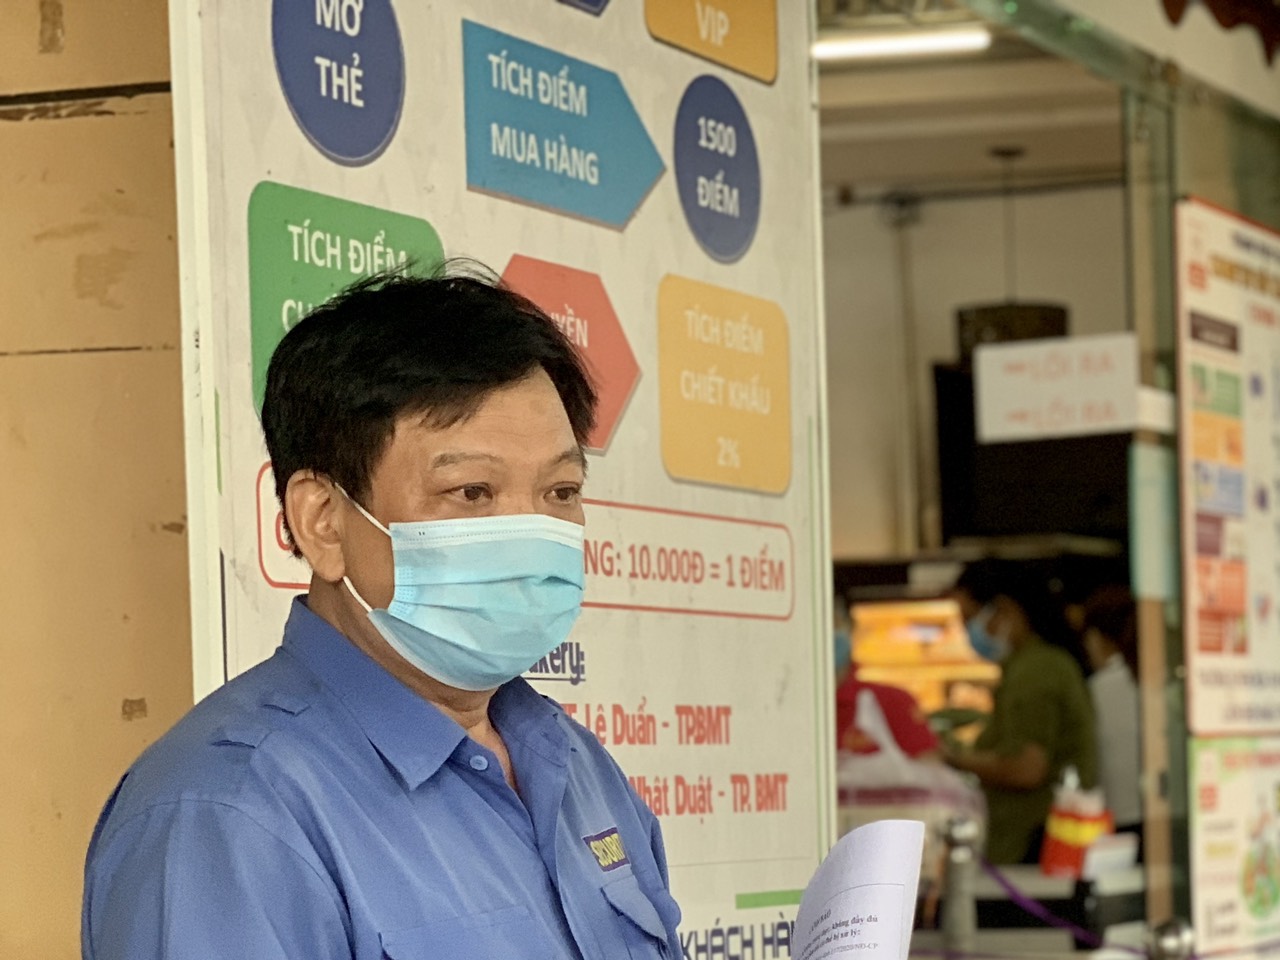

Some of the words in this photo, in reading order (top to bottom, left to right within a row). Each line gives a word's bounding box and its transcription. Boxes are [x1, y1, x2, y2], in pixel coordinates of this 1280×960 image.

[695, 1, 730, 46] VIP
[314, 52, 365, 108] THẺ
[488, 50, 534, 100] TÍCH
[491, 122, 541, 168] MUA
[544, 134, 600, 186] HÀNG
[697, 116, 737, 158] 1500
[287, 219, 343, 271] TÍCH
[683, 304, 721, 346] TÍCH
[680, 364, 725, 406] CHIẾT
[717, 436, 741, 470] 2%
[584, 539, 622, 578] NG:
[627, 543, 705, 585] 10.000Đ
[612, 696, 658, 746] Duẩn
[674, 774, 714, 825] Duật
[754, 772, 789, 812] BMT
[761, 911, 796, 960] HÀ
